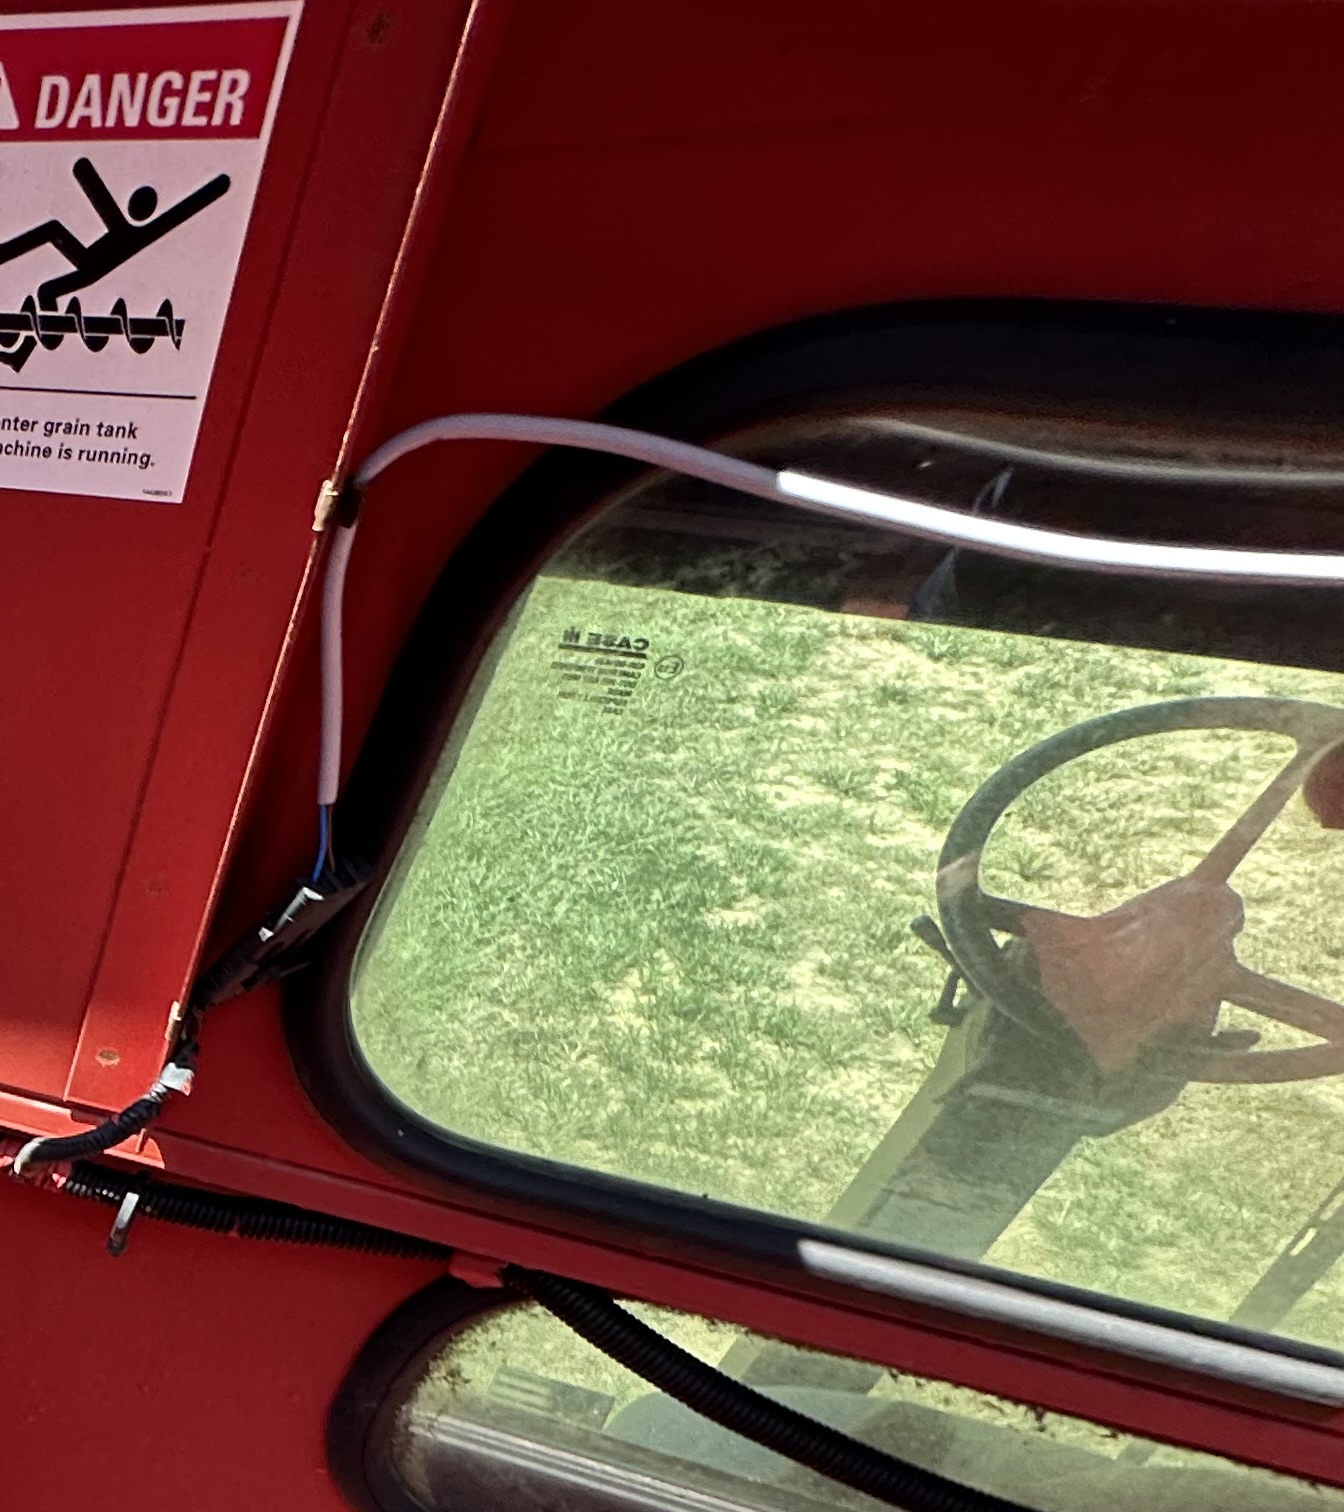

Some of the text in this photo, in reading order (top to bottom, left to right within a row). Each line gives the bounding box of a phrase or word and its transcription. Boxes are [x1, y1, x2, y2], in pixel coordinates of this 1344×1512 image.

[34, 68, 251, 130] DANGER
[43, 418, 91, 438] grain
[96, 422, 139, 440] tank
[57, 443, 72, 460] is
[77, 448, 156, 471] running.
